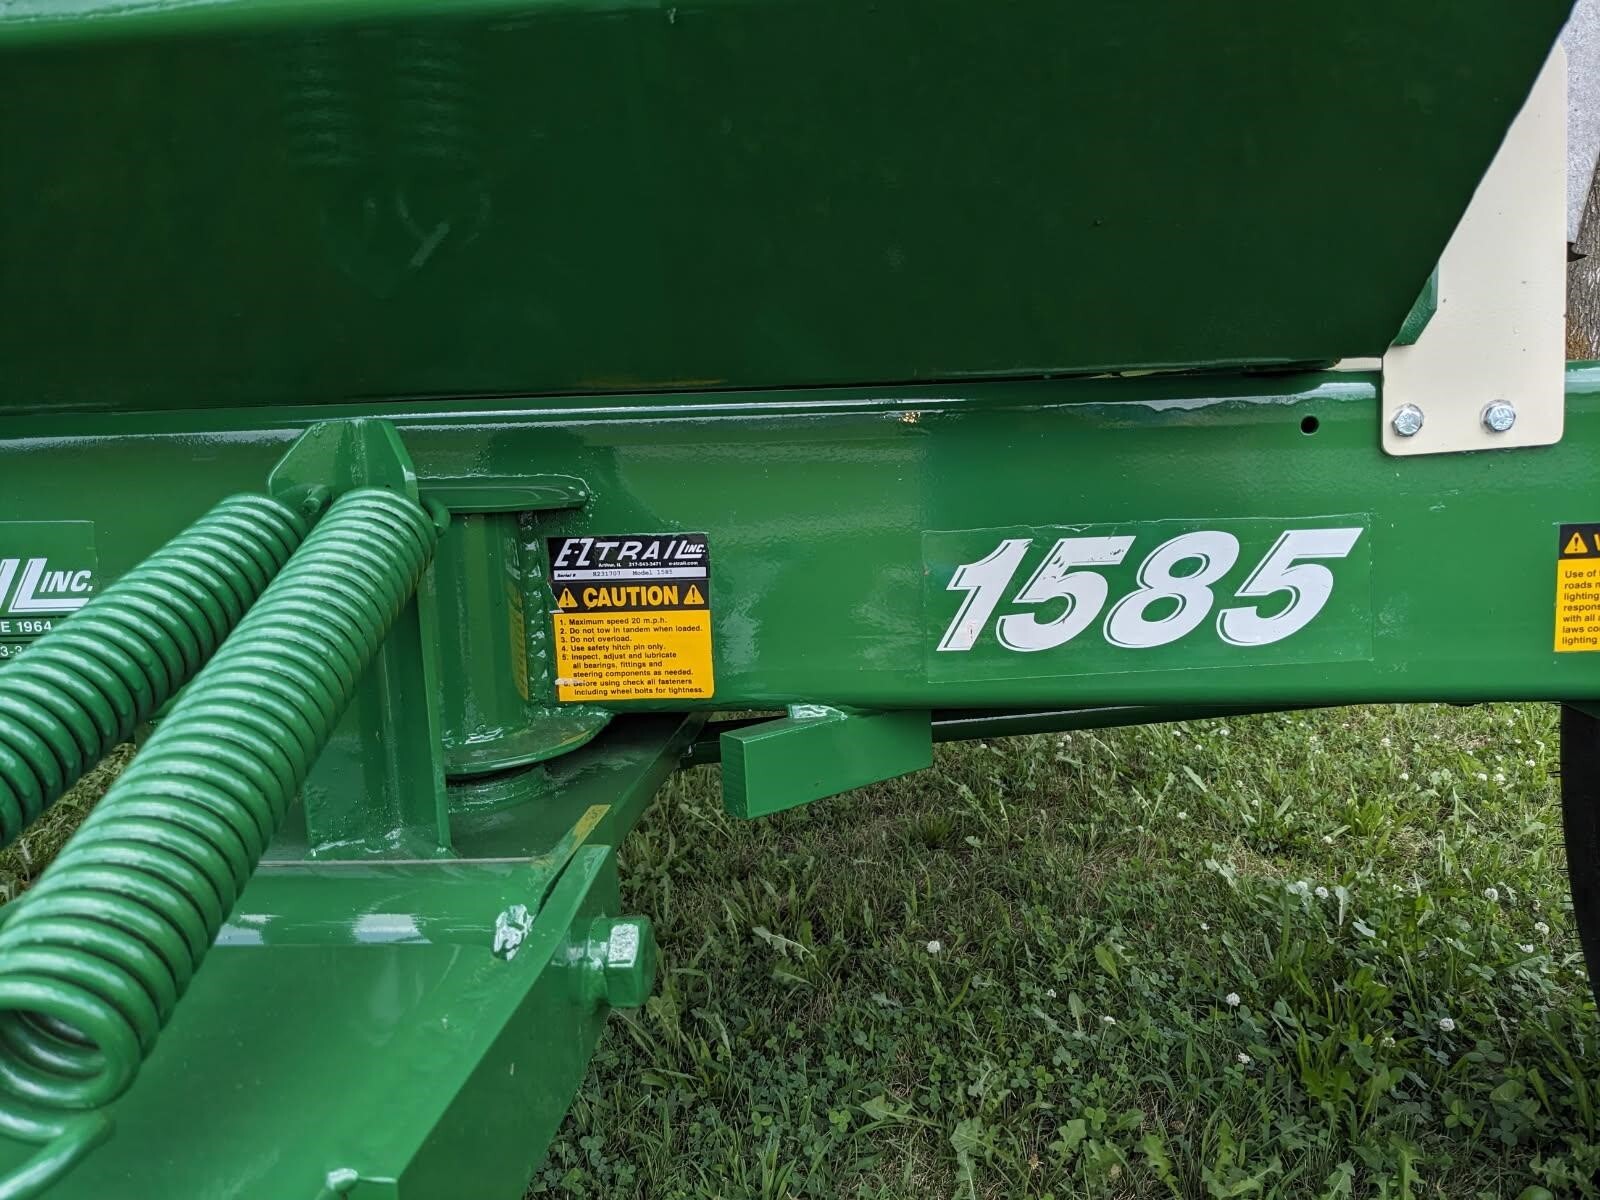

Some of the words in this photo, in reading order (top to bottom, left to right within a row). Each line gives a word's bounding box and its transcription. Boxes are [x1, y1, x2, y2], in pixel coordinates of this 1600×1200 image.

[595, 540, 702, 560] TRAIL
[684, 544, 705, 553] INC.
[1565, 570, 1584, 579] Use
[1587, 570, 1597, 578] of
[40, 570, 93, 592] INC.
[1564, 581, 1592, 589] roads
[936, 528, 1364, 652] 1585
[583, 586, 678, 608] CAUTION
[1563, 592, 1599, 602] lighting
[1563, 614, 1582, 622] with
[1584, 614, 1595, 622] all
[16, 621, 52, 633] 1964
[1562, 625, 1584, 633] laws
[1562, 636, 1597, 646] lighting
[604, 653, 625, 661] adjust
